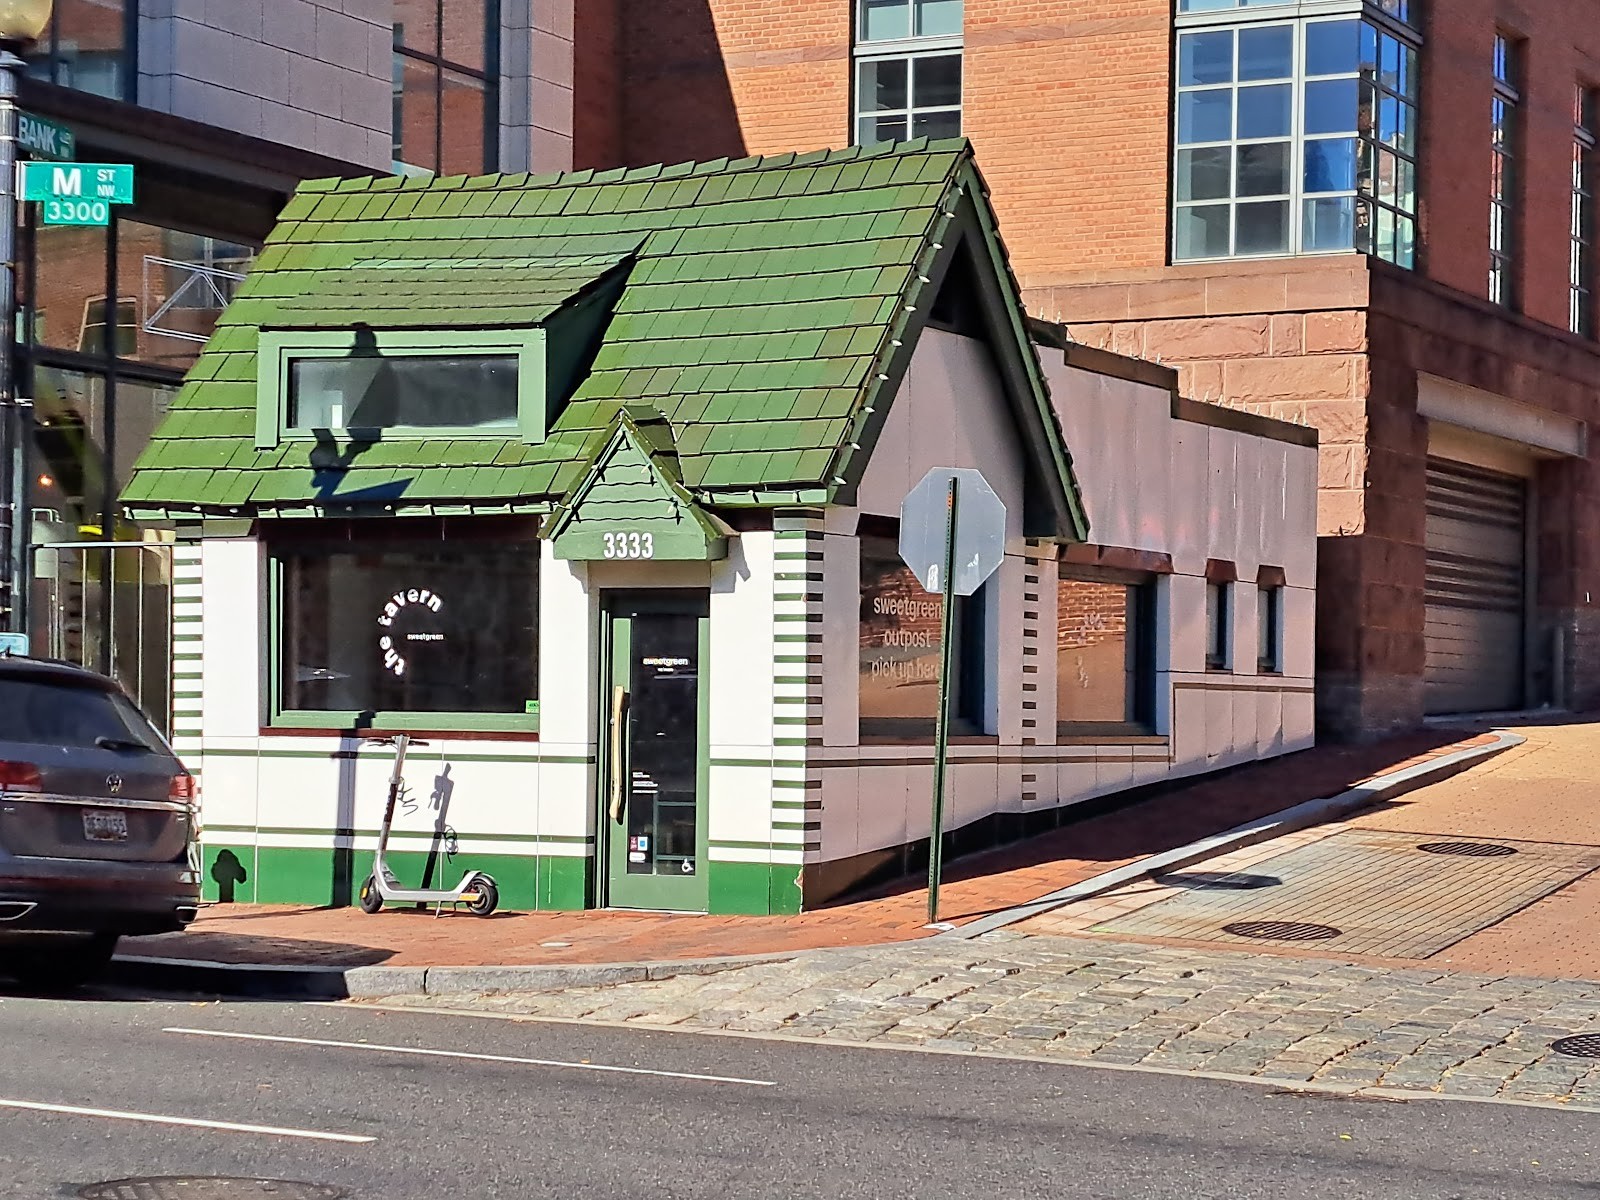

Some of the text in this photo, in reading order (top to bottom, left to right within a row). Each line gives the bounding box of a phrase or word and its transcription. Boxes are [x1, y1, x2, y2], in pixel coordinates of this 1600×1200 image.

[19, 116, 57, 155] BANK
[53, 168, 81, 195] M
[97, 169, 115, 182] ST
[97, 185, 115, 197] NW
[48, 201, 106, 221] 3300
[603, 532, 654, 559] 3333
[873, 597, 942, 622] sweetgreen
[377, 588, 442, 676] the tavern
[406, 632, 444, 641] sweetgreen
[884, 628, 931, 652] outpost
[871, 656, 897, 682] pick
[899, 660, 914, 683] up
